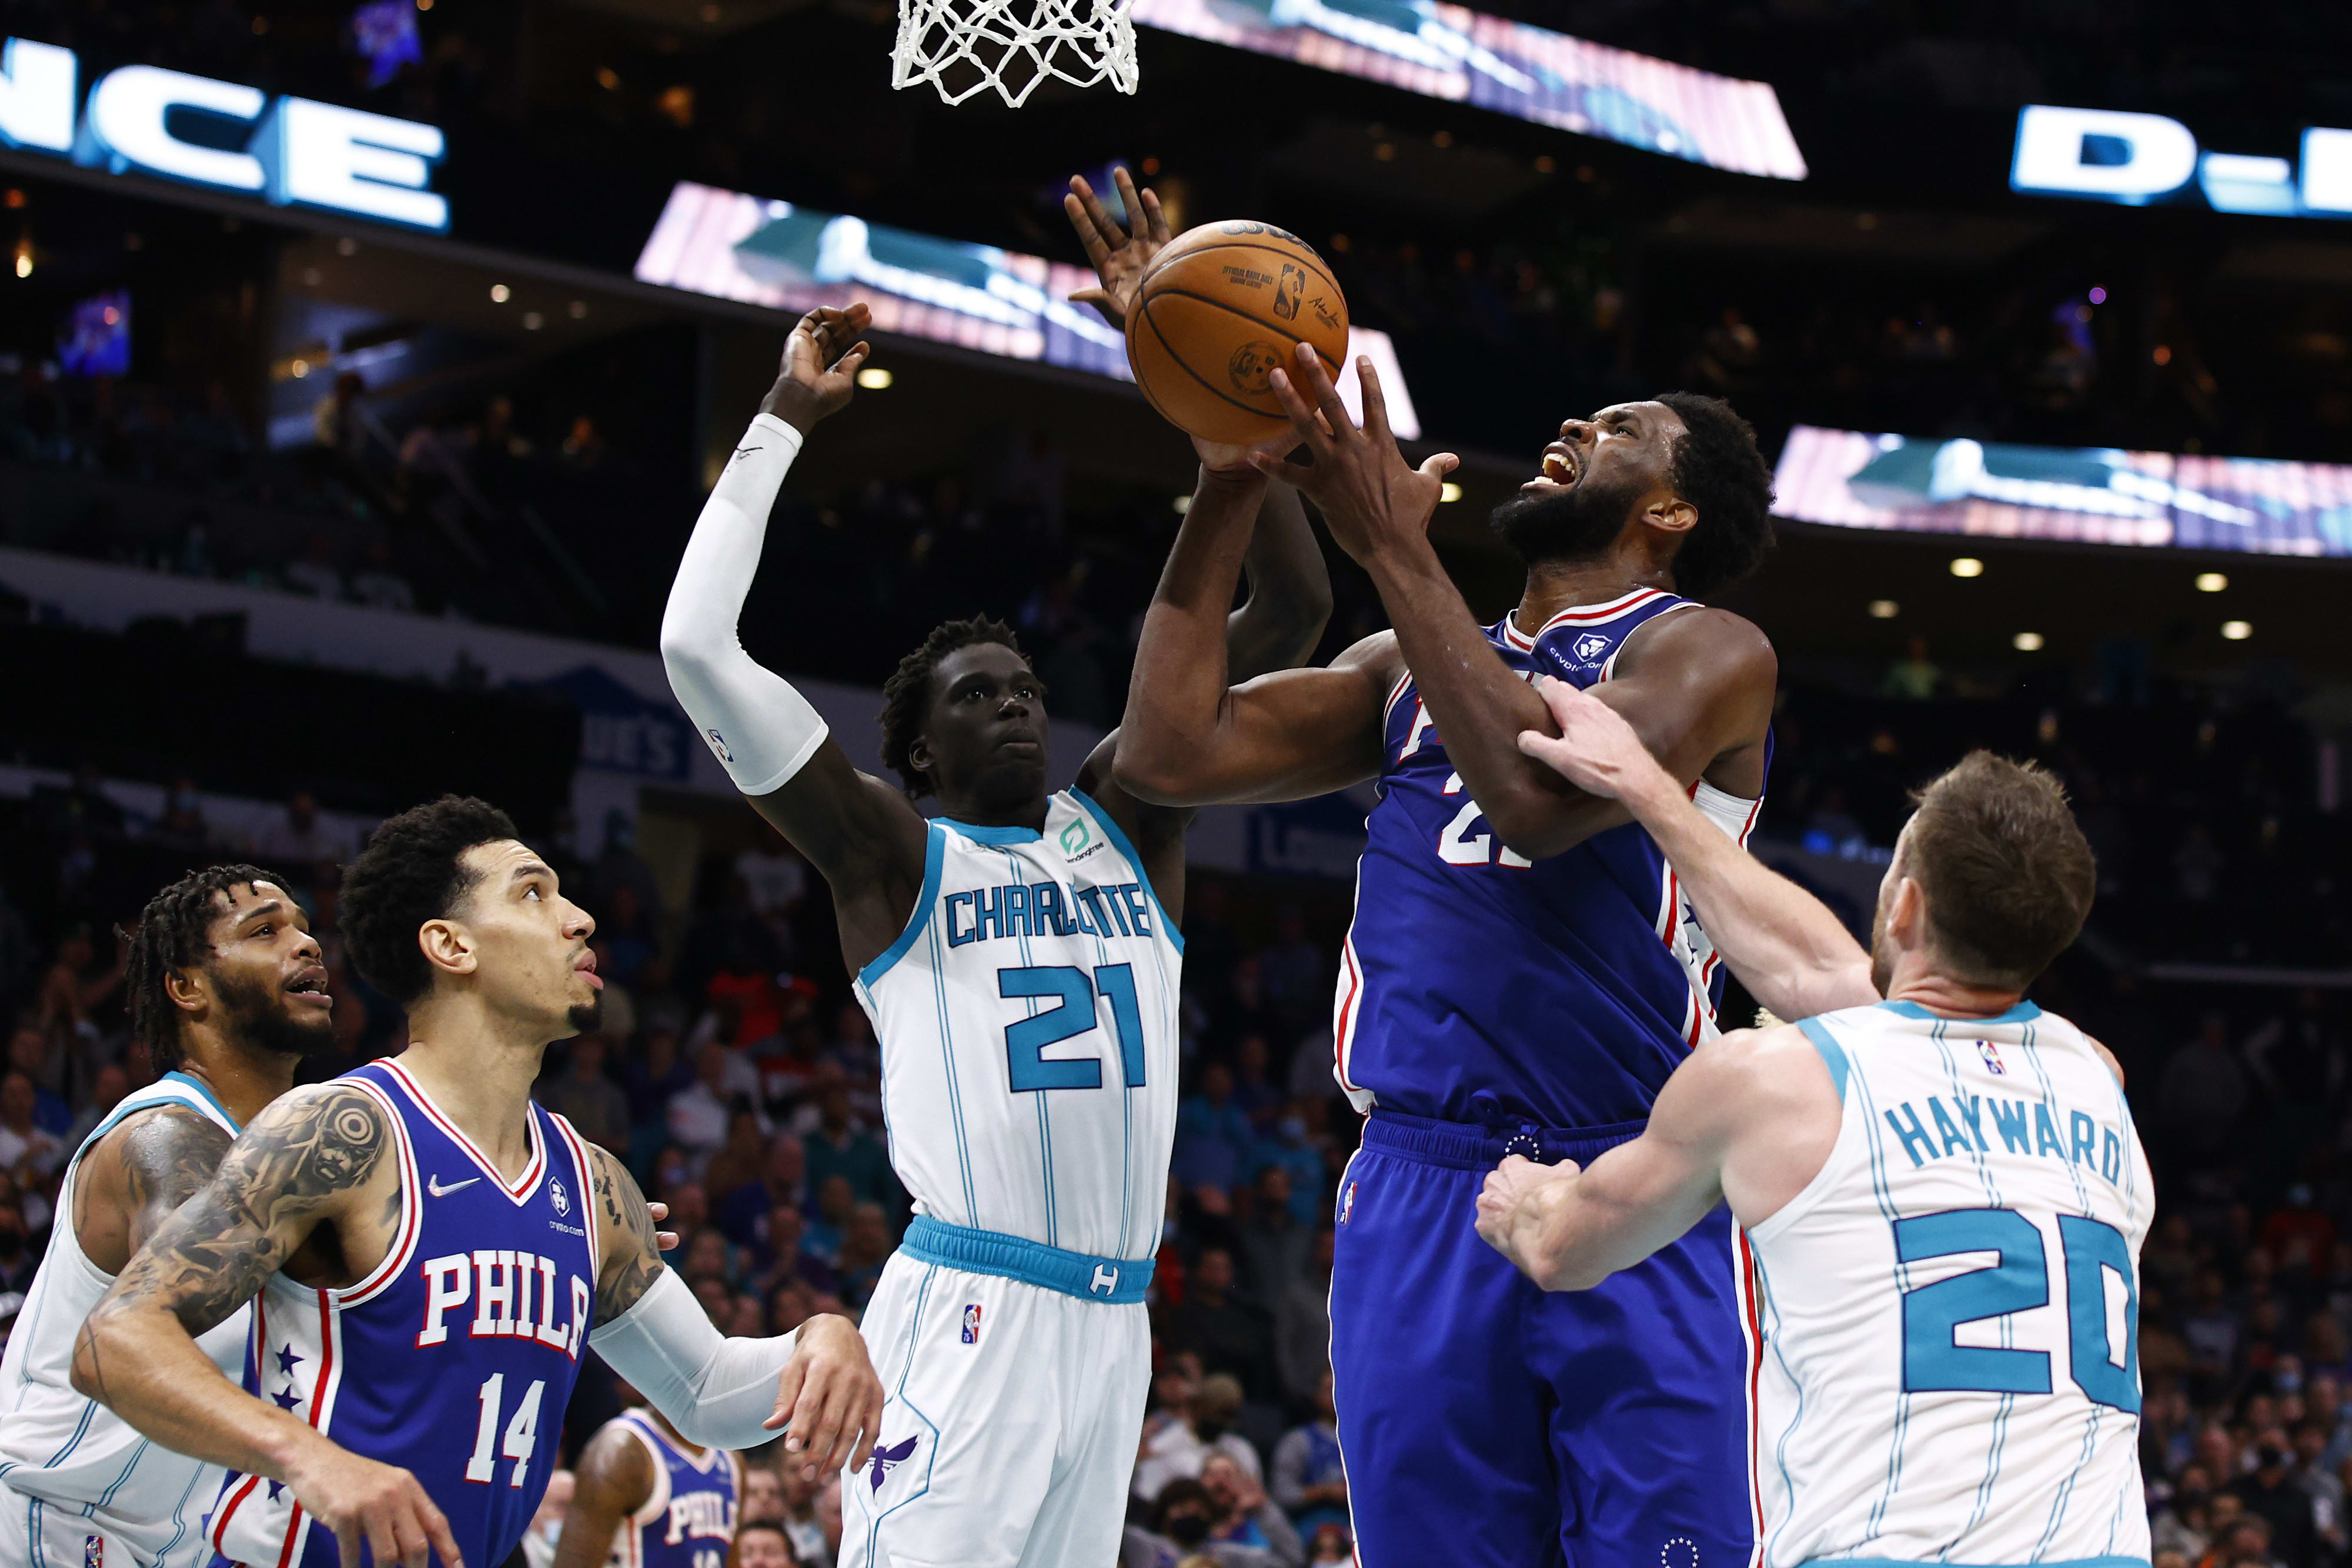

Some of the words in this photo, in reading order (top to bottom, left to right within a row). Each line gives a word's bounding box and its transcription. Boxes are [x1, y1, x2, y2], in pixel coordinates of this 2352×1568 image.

[1436, 771, 1533, 870] 2
[997, 962, 1146, 1093] 21
[1884, 1095, 2120, 1187] HAYWARD
[1892, 1207, 2143, 1417] 20
[463, 1372, 546, 1489] 14
